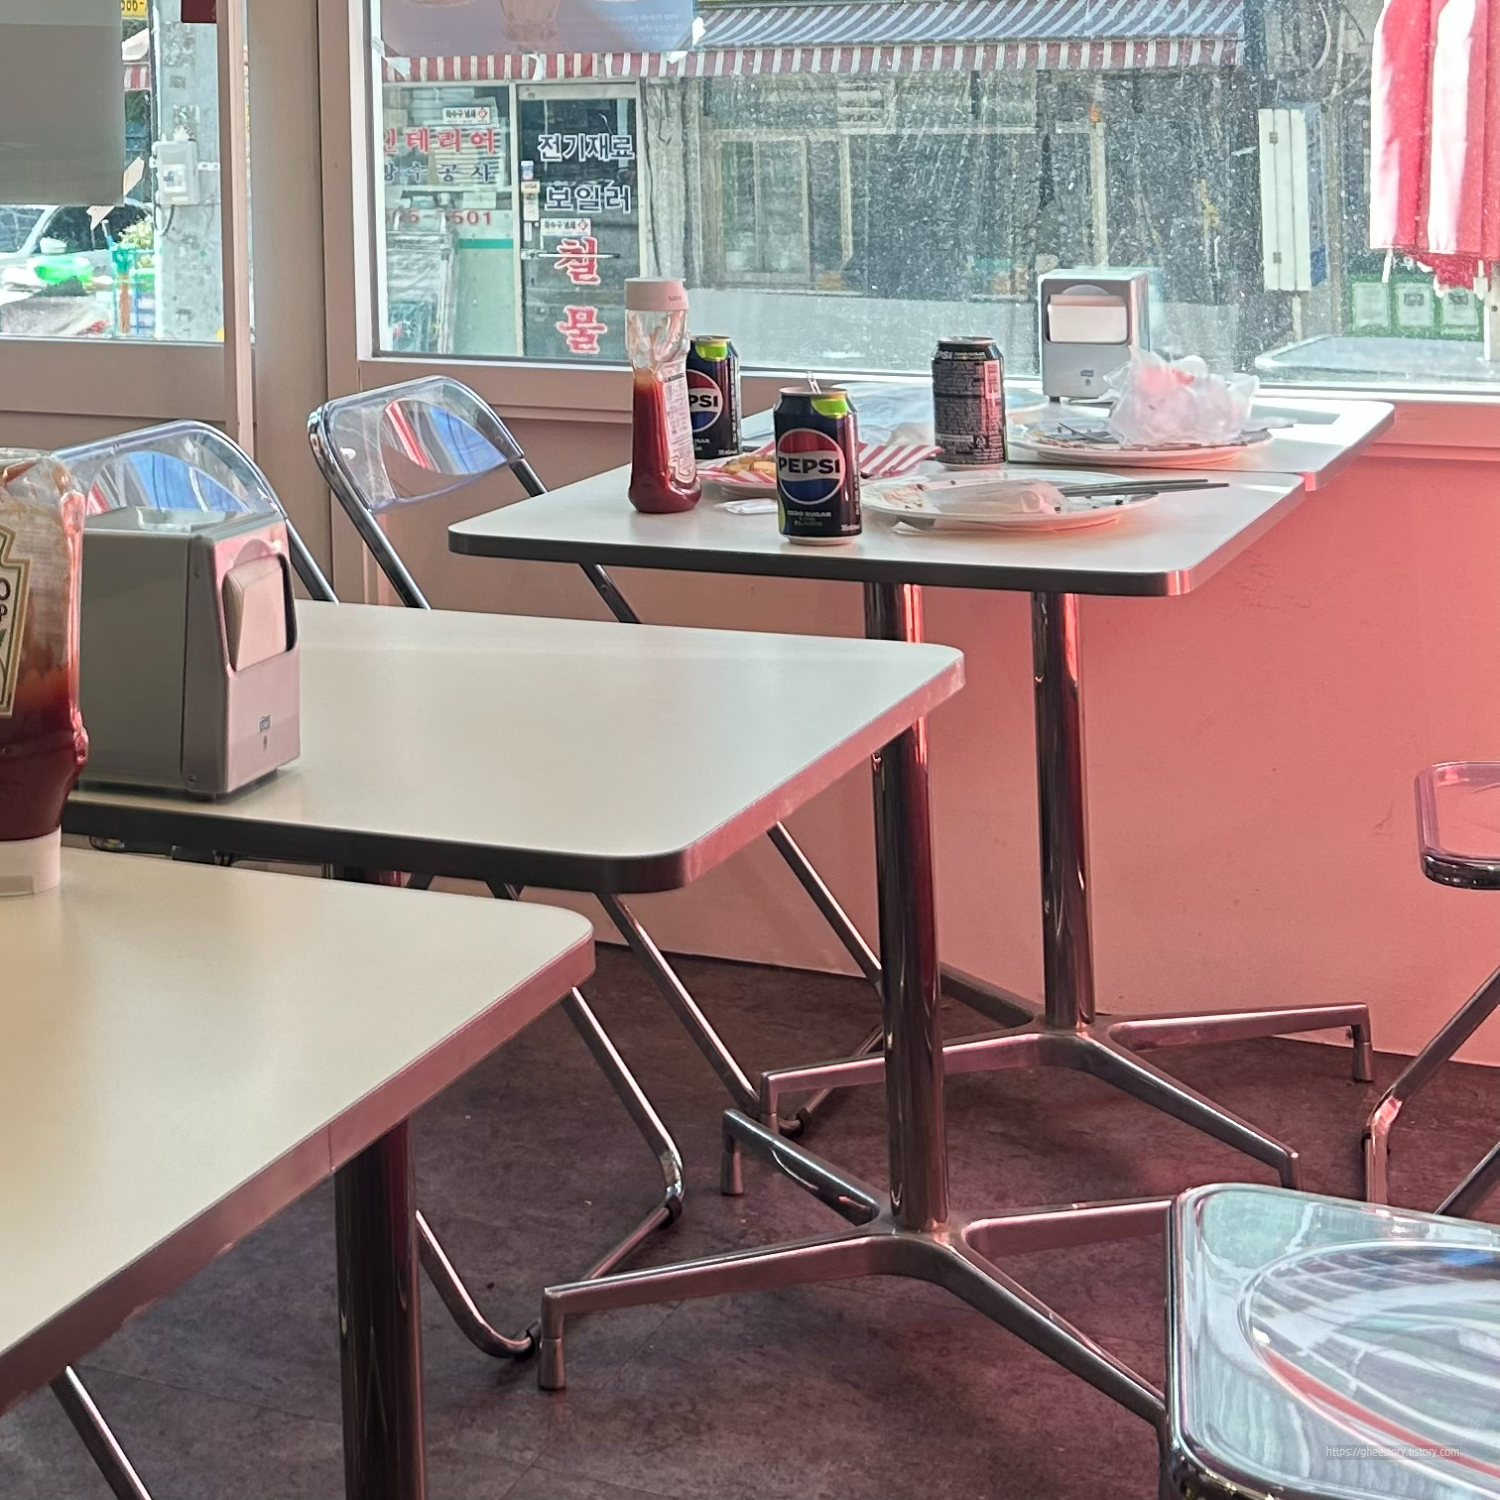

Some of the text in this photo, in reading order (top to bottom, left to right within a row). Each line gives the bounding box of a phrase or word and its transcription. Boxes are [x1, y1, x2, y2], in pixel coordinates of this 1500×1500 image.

[537, 132, 636, 162] 전기재료
[544, 184, 632, 214] 보일러
[778, 458, 841, 474] PEPSI
